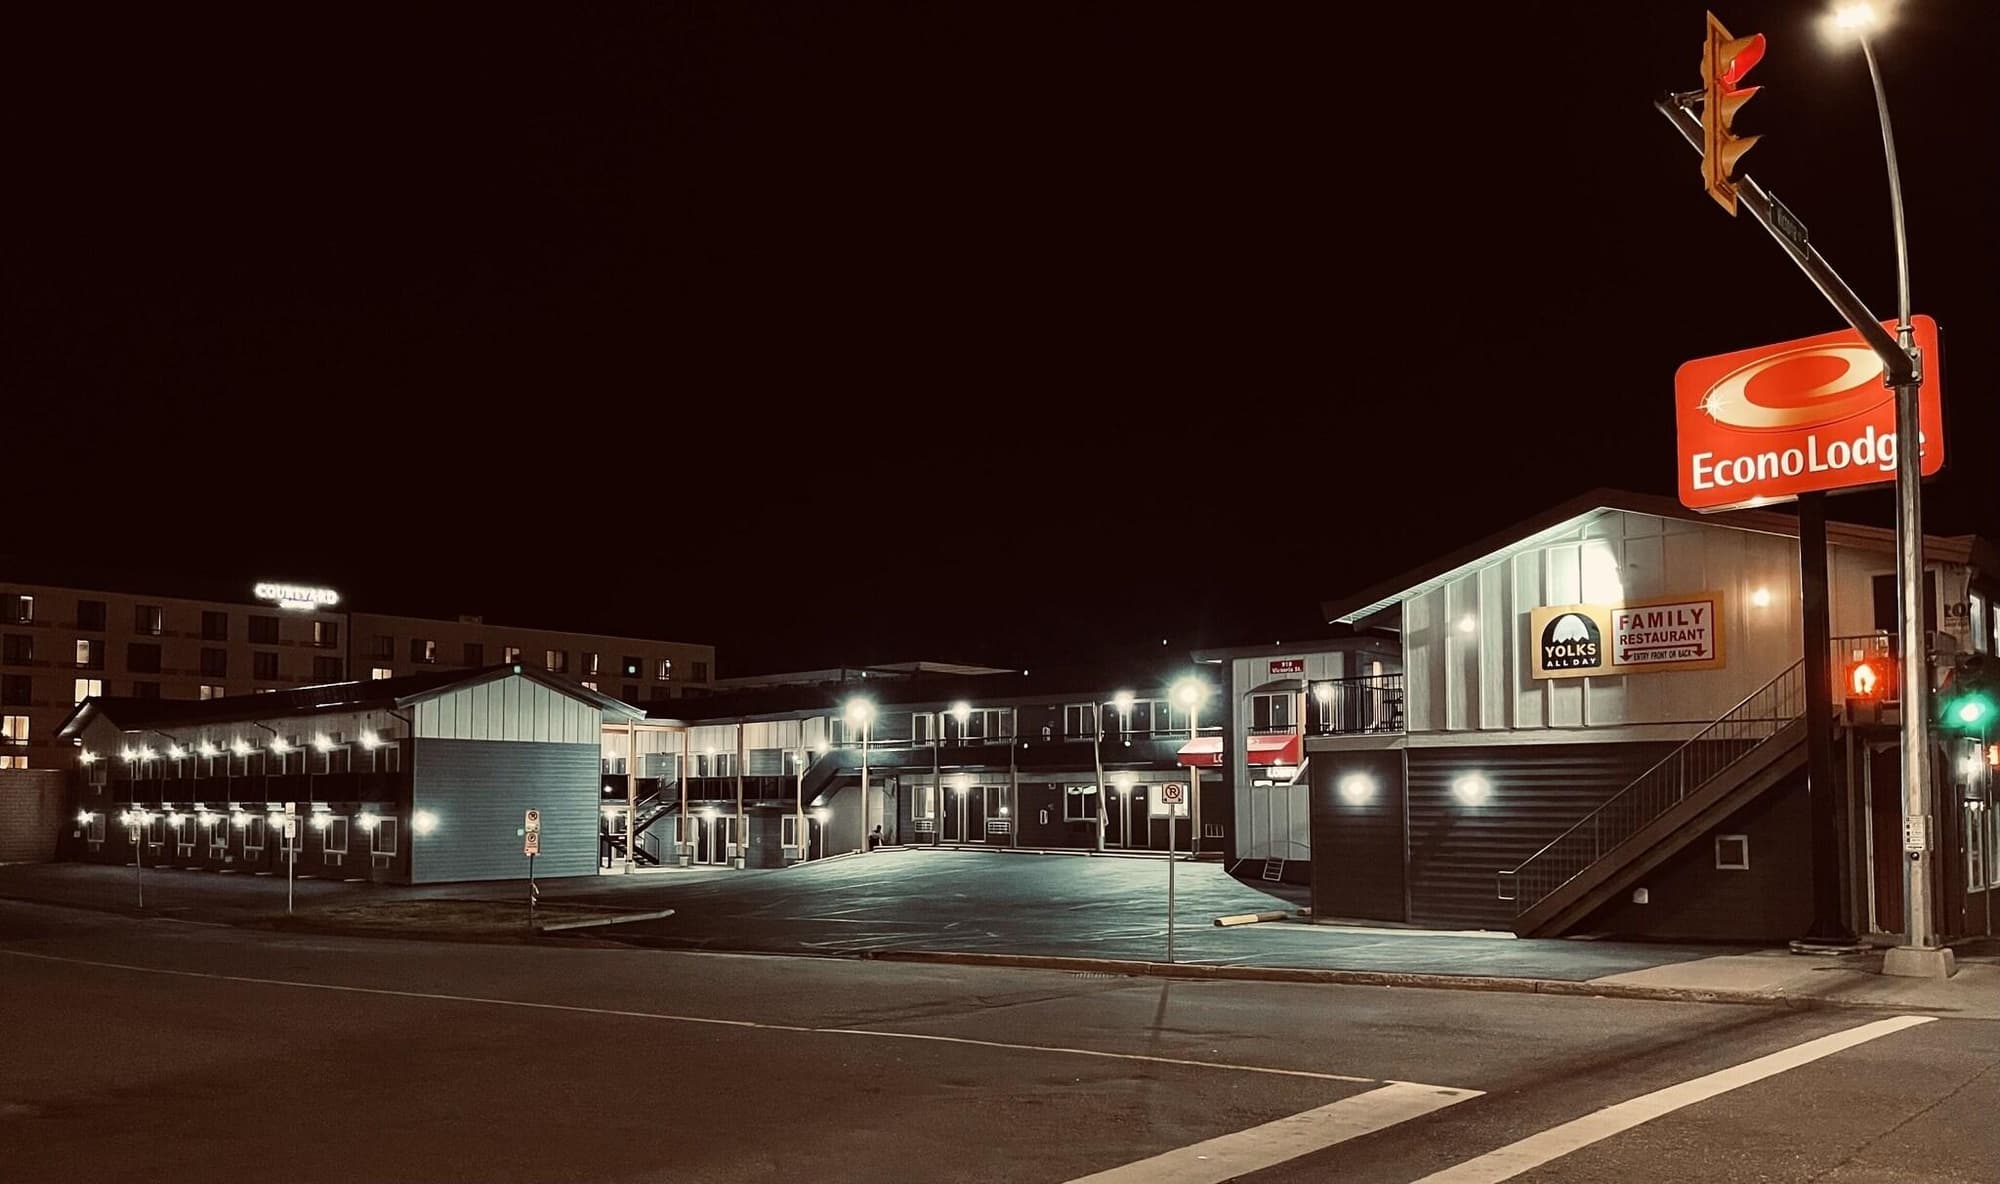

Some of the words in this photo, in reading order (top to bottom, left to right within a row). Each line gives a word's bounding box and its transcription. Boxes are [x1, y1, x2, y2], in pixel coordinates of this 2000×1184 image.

[1619, 608, 1705, 631] FAMILY
[1619, 628, 1705, 646] RESTAURANT
[1545, 643, 1596, 658] YOLKS
[1633, 651, 1649, 661] ENTRY
[1650, 650, 1667, 660] FRONT
[1668, 649, 1676, 658] OR
[1678, 648, 1691, 658] BACK
[1573, 657, 1597, 666] DAY
